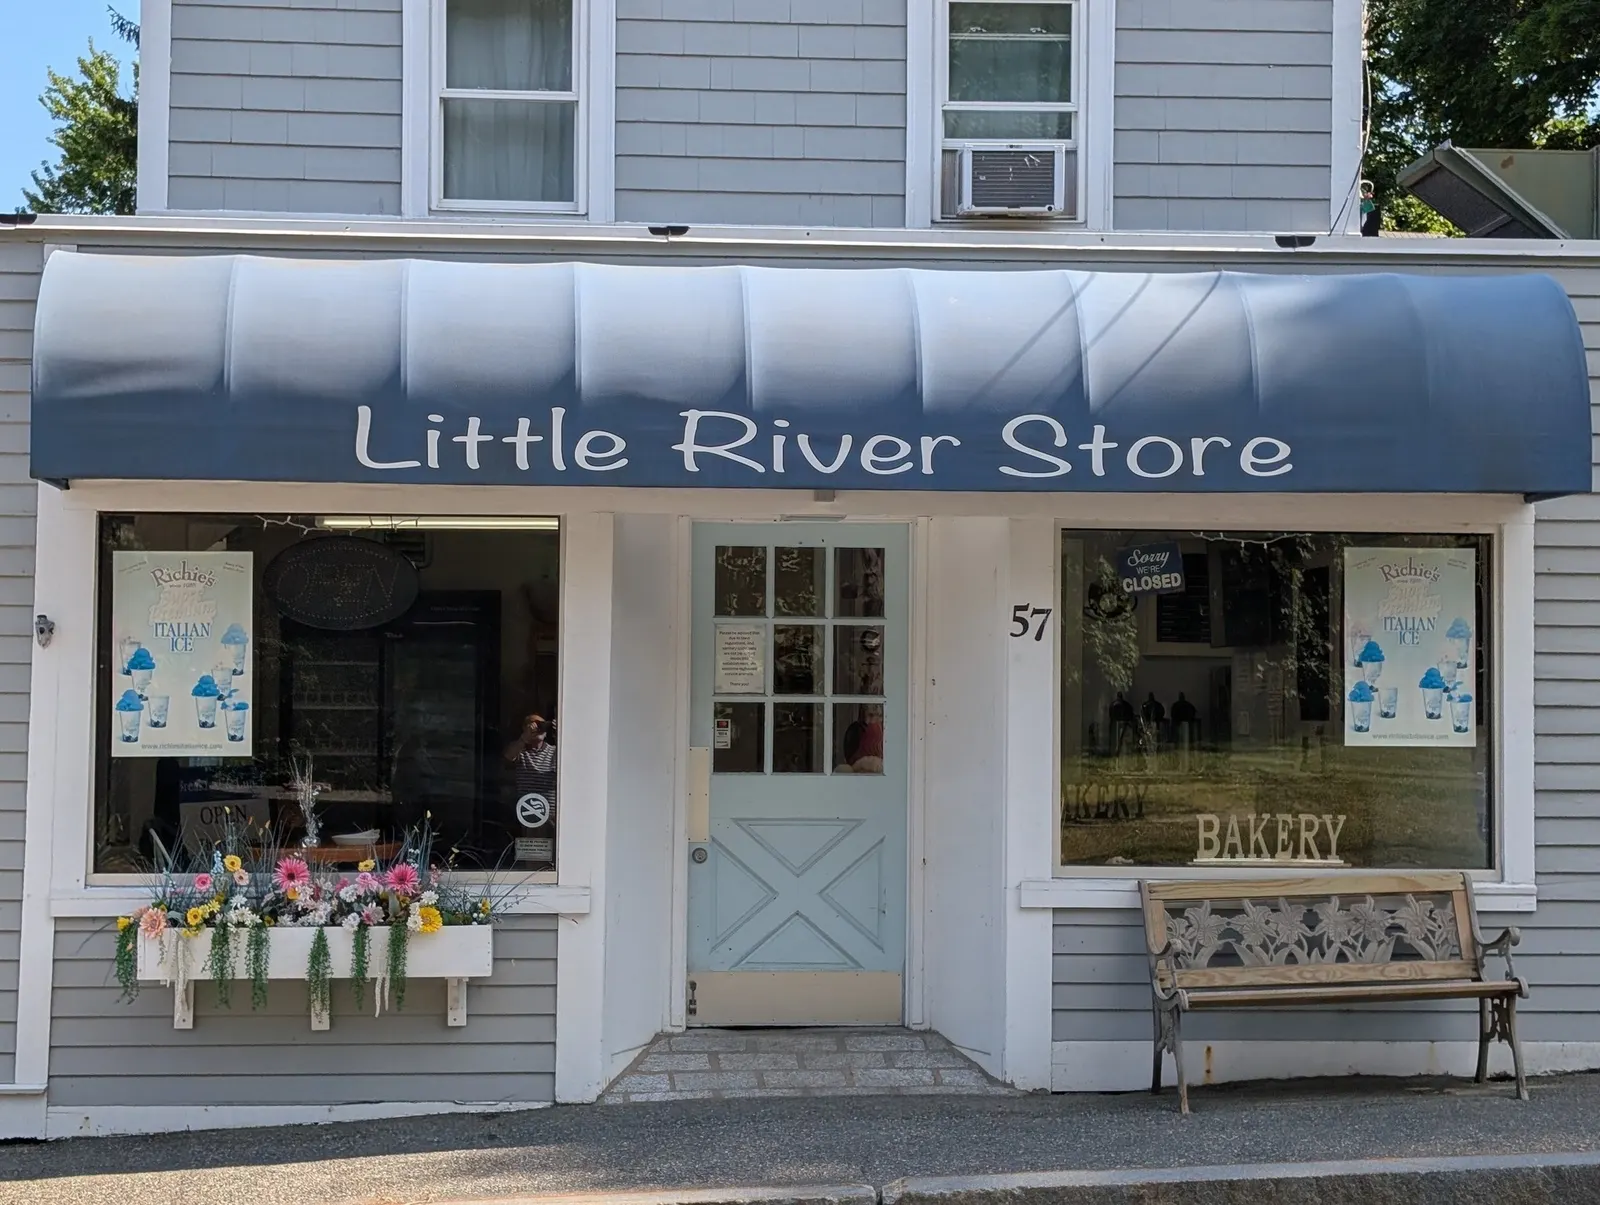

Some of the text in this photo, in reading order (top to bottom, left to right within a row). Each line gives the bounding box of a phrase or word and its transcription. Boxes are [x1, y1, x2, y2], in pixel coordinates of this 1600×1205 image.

[355, 405, 1295, 479] Little River Store
[1127, 549, 1170, 568] Sorry
[150, 560, 217, 588] Richie's
[1378, 557, 1441, 583] Richie's
[1122, 572, 1182, 593] CLOSED
[154, 622, 210, 637] ITALIAN
[1009, 602, 1052, 641] 57
[1383, 617, 1436, 631] ITALIAN
[170, 637, 194, 651] ICE
[1398, 631, 1420, 645] ICE
[1195, 812, 1348, 861] BAKERY
